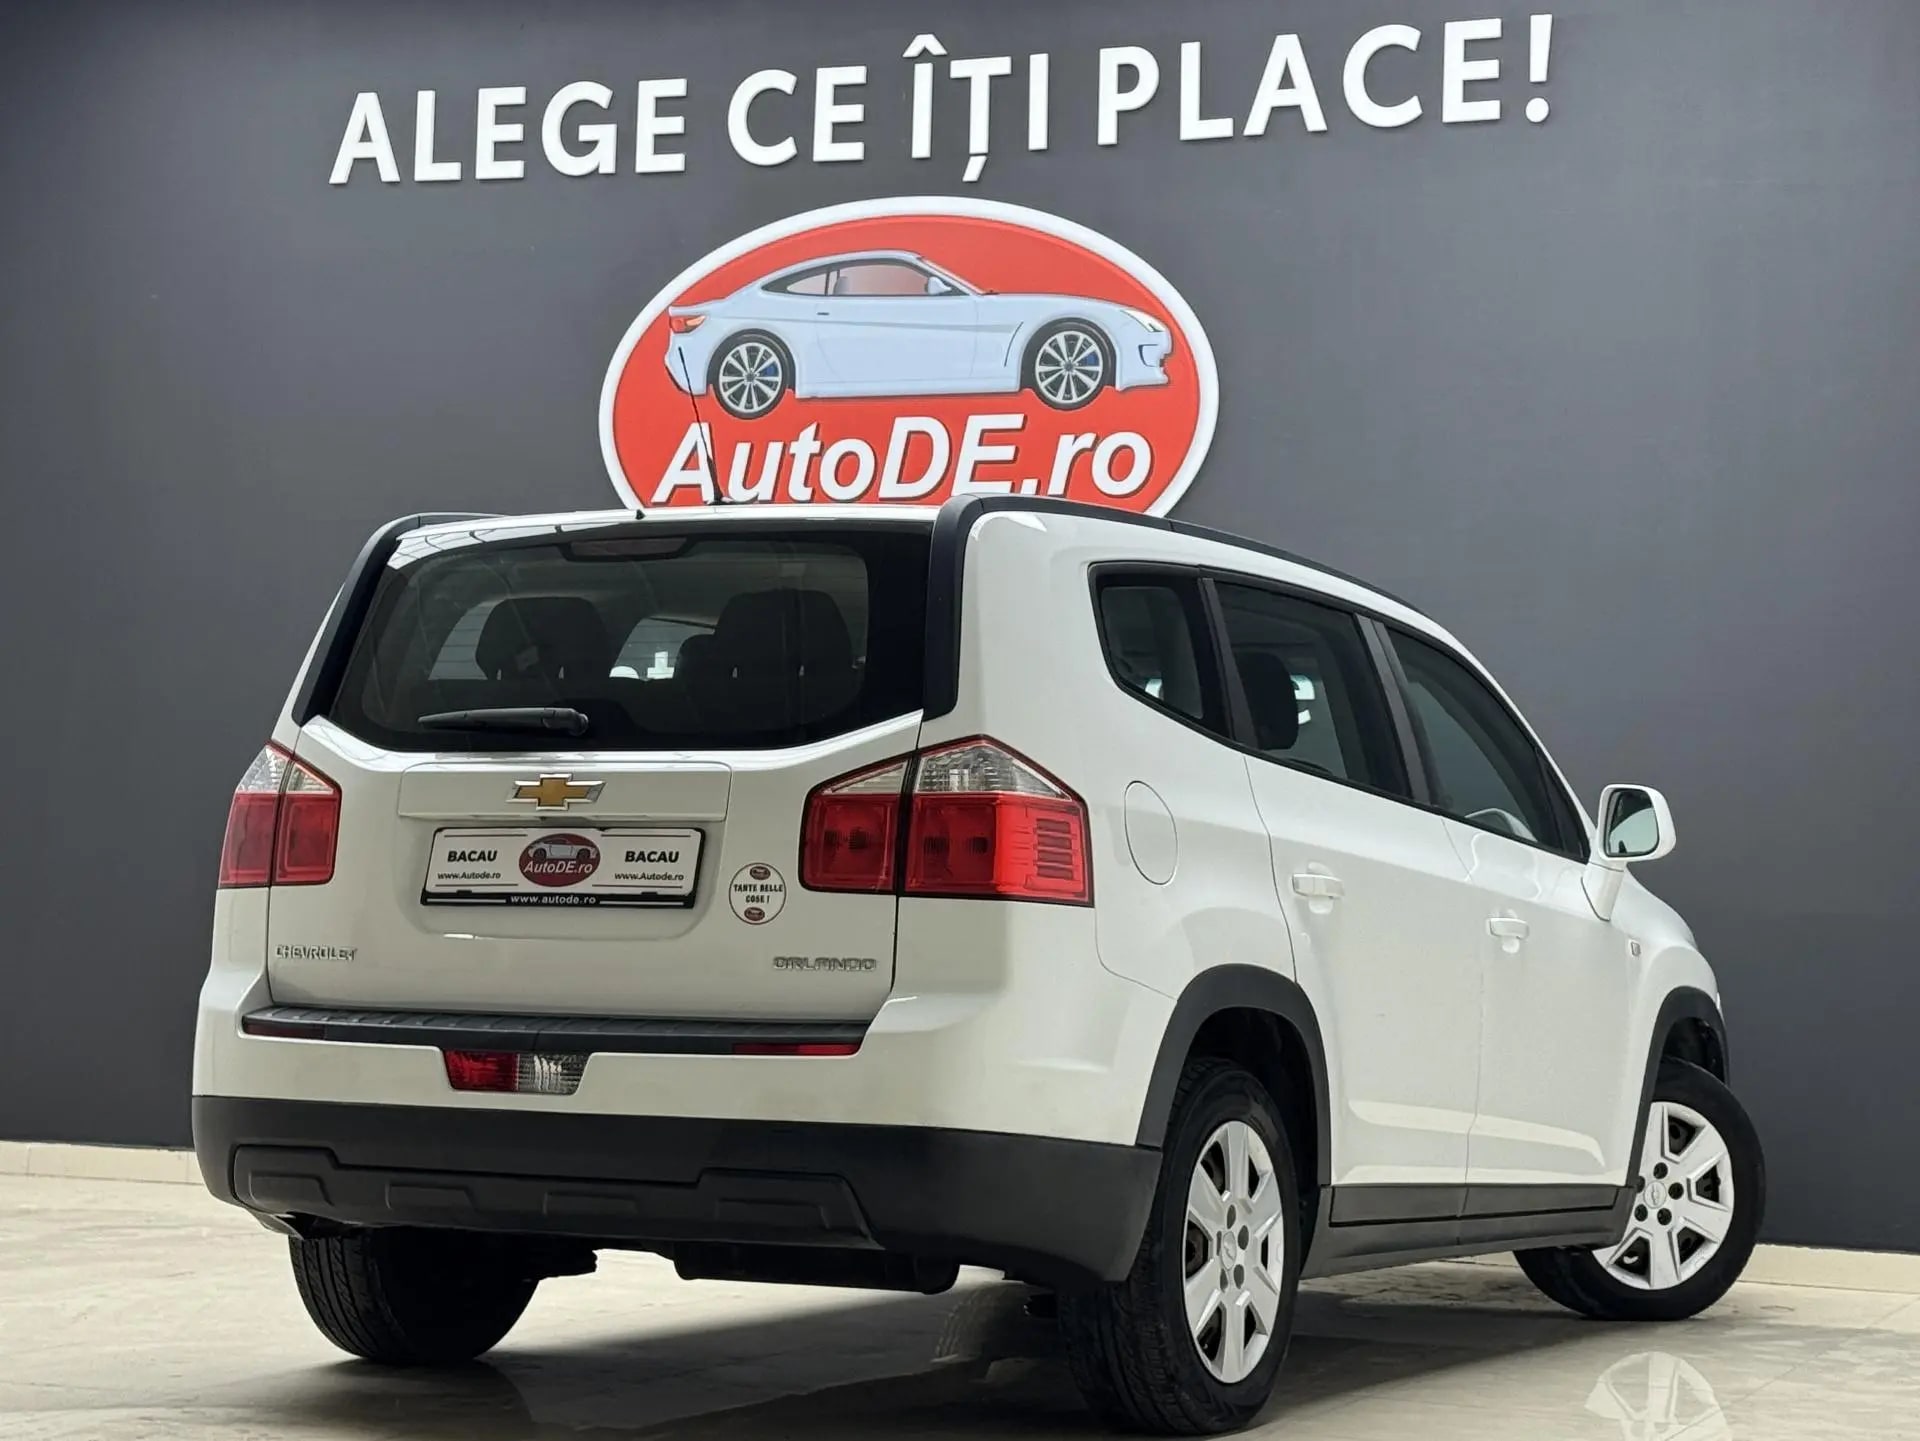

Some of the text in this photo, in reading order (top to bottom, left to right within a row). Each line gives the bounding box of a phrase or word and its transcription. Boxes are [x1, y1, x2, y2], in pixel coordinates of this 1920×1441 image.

[328, 78, 688, 184] ALEGE
[727, 65, 867, 164] CE
[1097, 14, 1553, 147] PLACE!
[651, 413, 1154, 504] AutoDE.ro
[447, 850, 498, 863] BACAU
[624, 850, 680, 864] BACAU
[523, 859, 593, 875] AutoDE.ro
[733, 884, 757, 893] TANTE
[510, 894, 597, 905] www.autode.ro
[275, 944, 358, 960] CHEVROLET
[773, 956, 877, 972] ORLANDO
